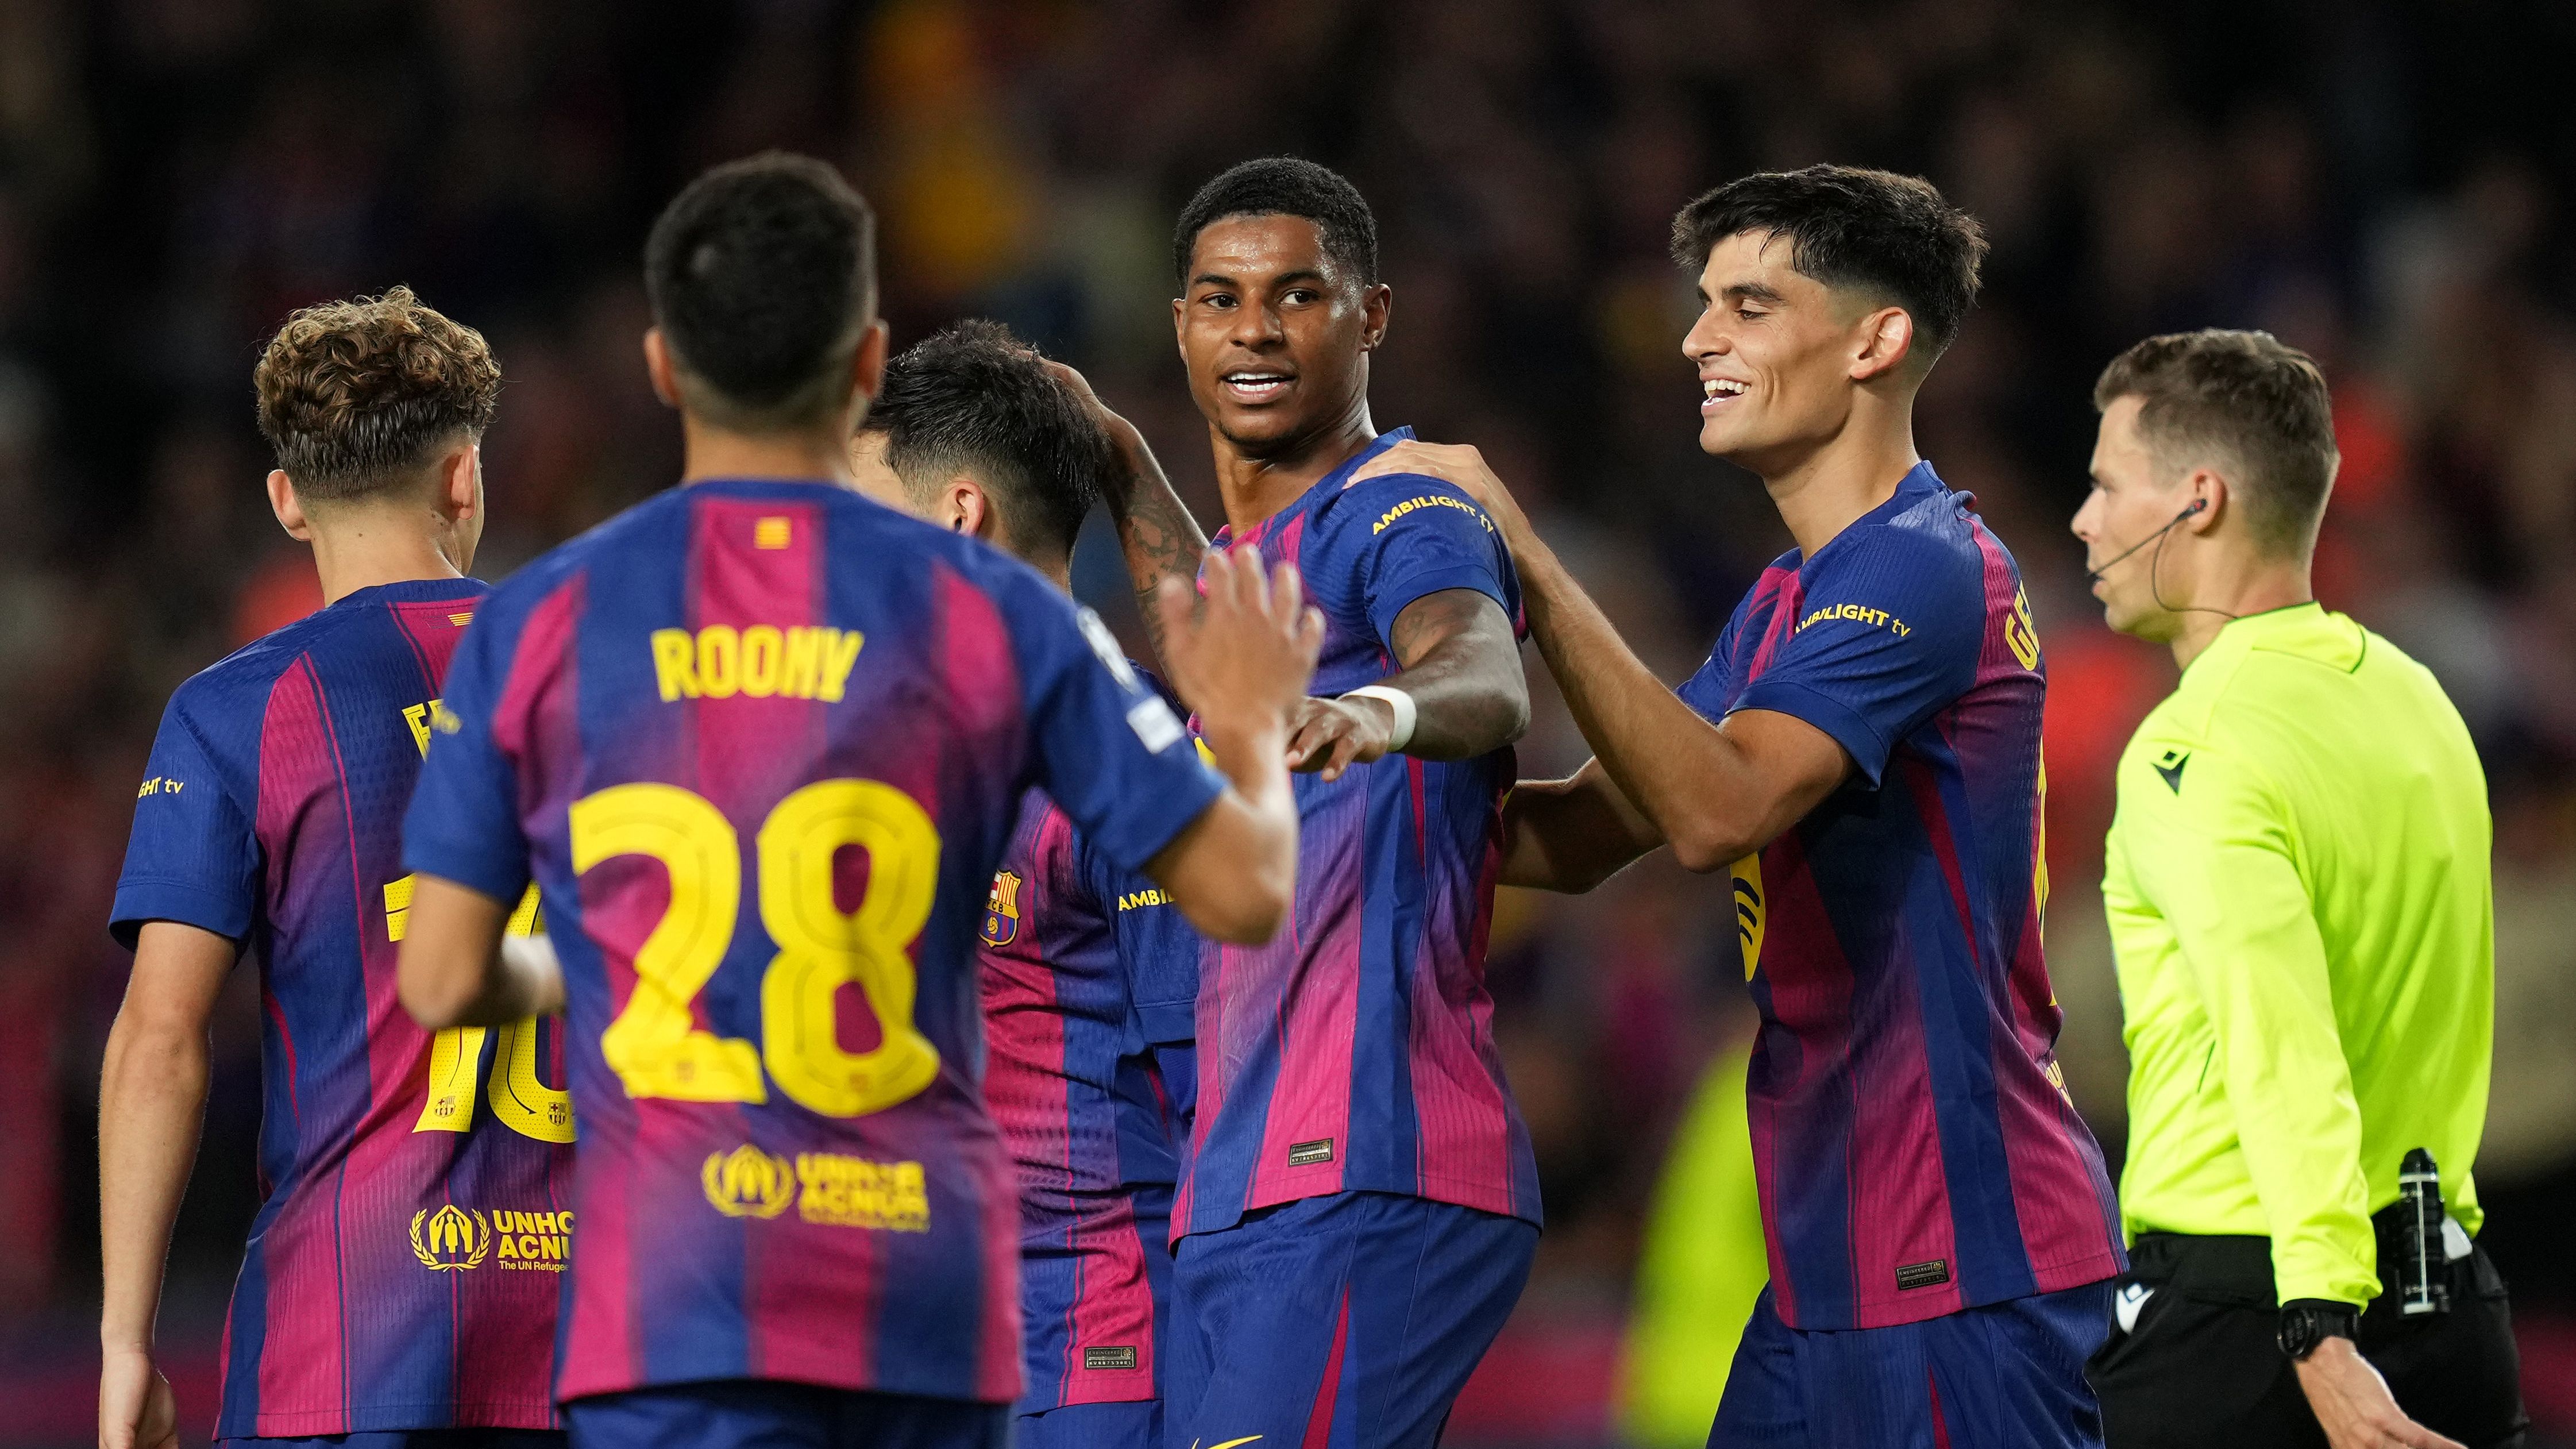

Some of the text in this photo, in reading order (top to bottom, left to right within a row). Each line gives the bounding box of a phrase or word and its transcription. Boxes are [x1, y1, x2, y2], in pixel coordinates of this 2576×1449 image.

[1372, 495, 1494, 535] AMBILIGHT tv
[1892, 618, 1911, 637] tv
[164, 779, 184, 794] tv
[569, 777, 942, 1118] 28
[492, 1209, 574, 1234] UNHC
[499, 1261, 516, 1270] The
[518, 1261, 532, 1270] UN
